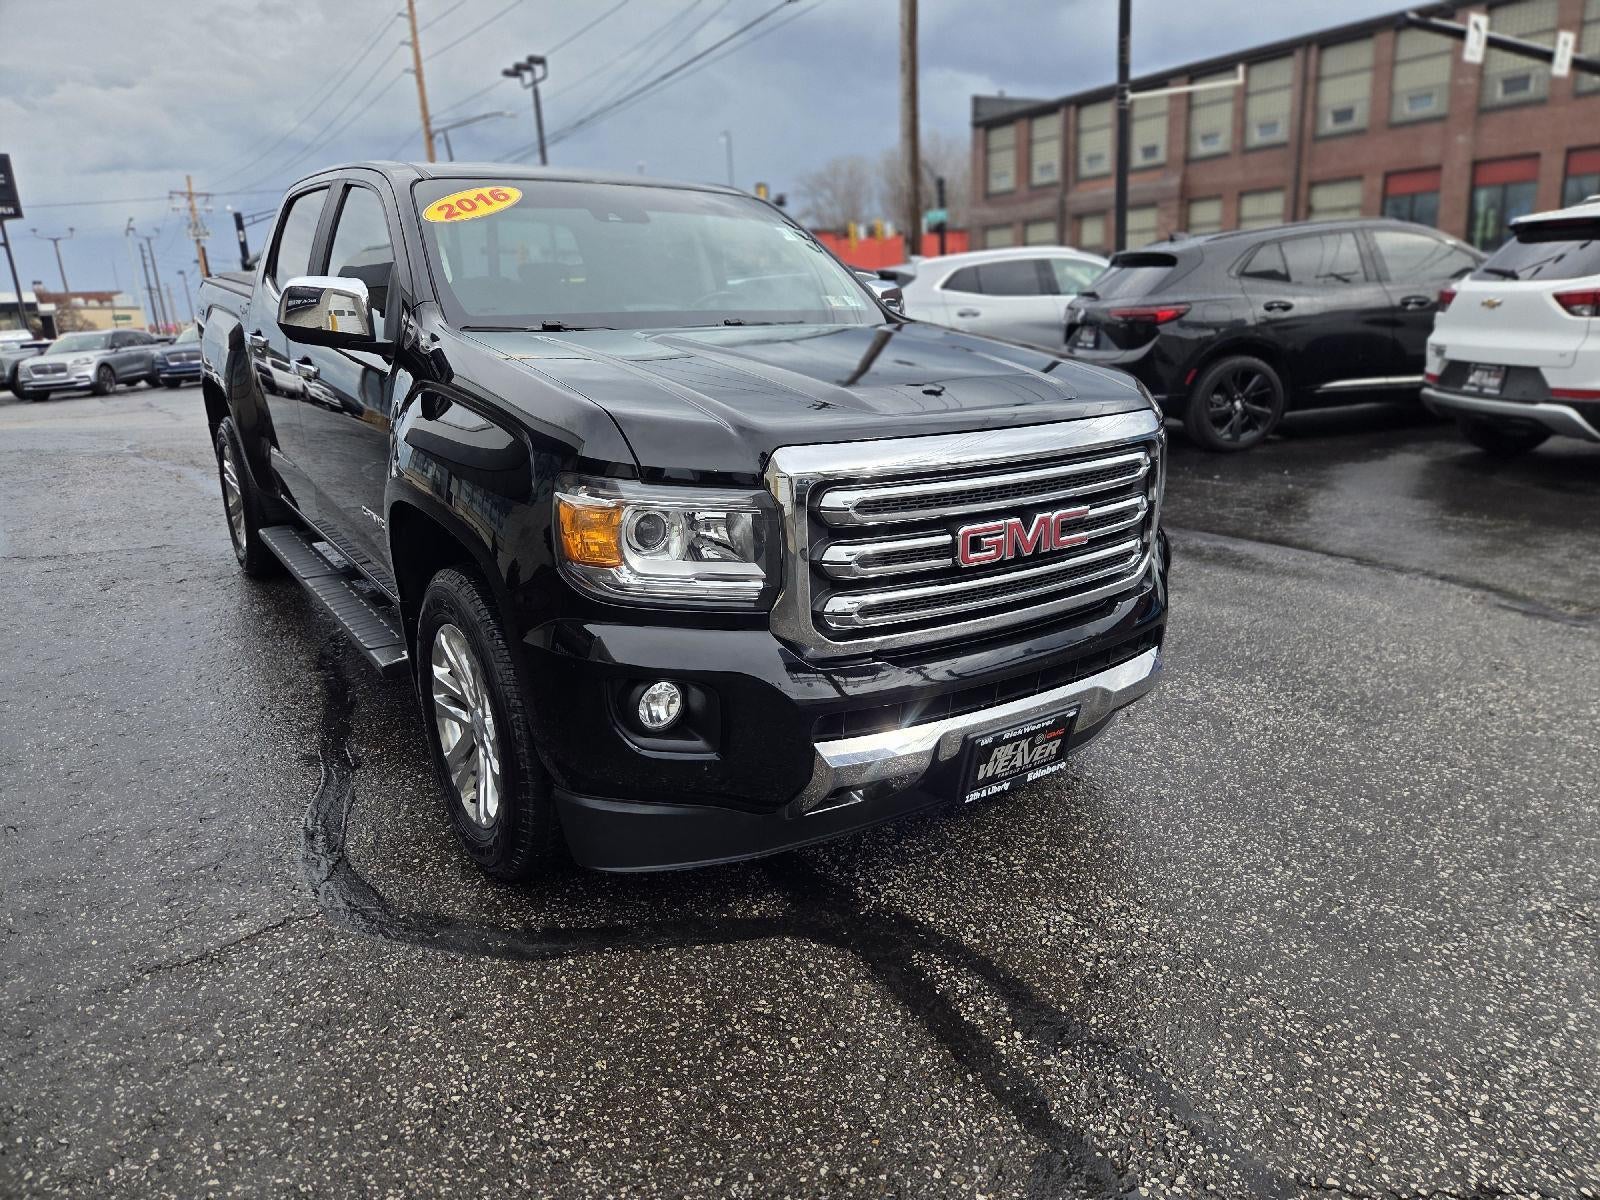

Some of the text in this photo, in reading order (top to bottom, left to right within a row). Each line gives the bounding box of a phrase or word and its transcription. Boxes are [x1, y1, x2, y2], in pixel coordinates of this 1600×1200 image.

[437, 188, 510, 220] 2016
[957, 505, 1090, 567] GMC
[1046, 728, 1065, 738] GMC
[978, 739, 1061, 780] WEAVER
[990, 737, 1034, 762] RICK
[1027, 761, 1066, 782] Edinboro
[988, 782, 1010, 795] Liberty
